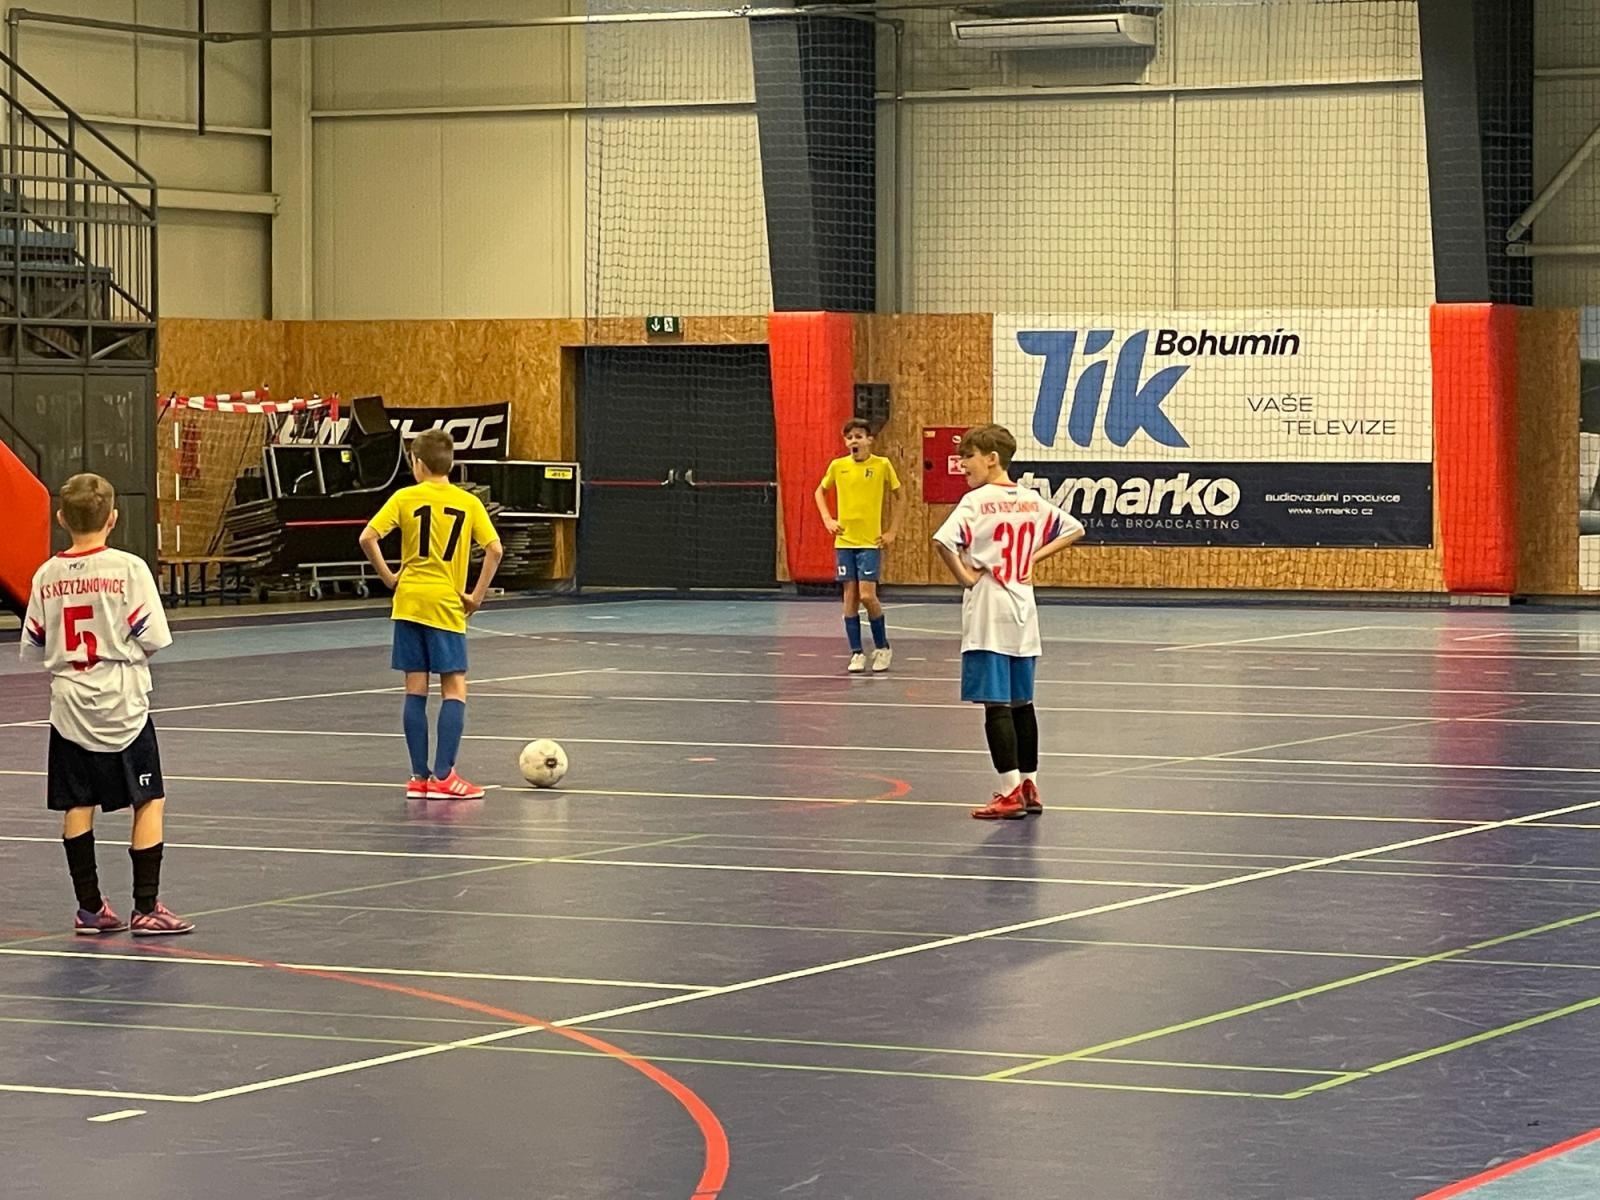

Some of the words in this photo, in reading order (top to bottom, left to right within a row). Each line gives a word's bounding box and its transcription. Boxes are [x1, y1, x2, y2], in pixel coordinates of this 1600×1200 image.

[1155, 328, 1300, 356] Bohumín
[1247, 393, 1314, 412] VAŠE
[1282, 419, 1397, 436] TELEVIZE
[413, 505, 465, 561] 17
[1126, 518, 1240, 530] BROADCASTING
[992, 521, 1036, 588] 30
[63, 605, 98, 671] 5
